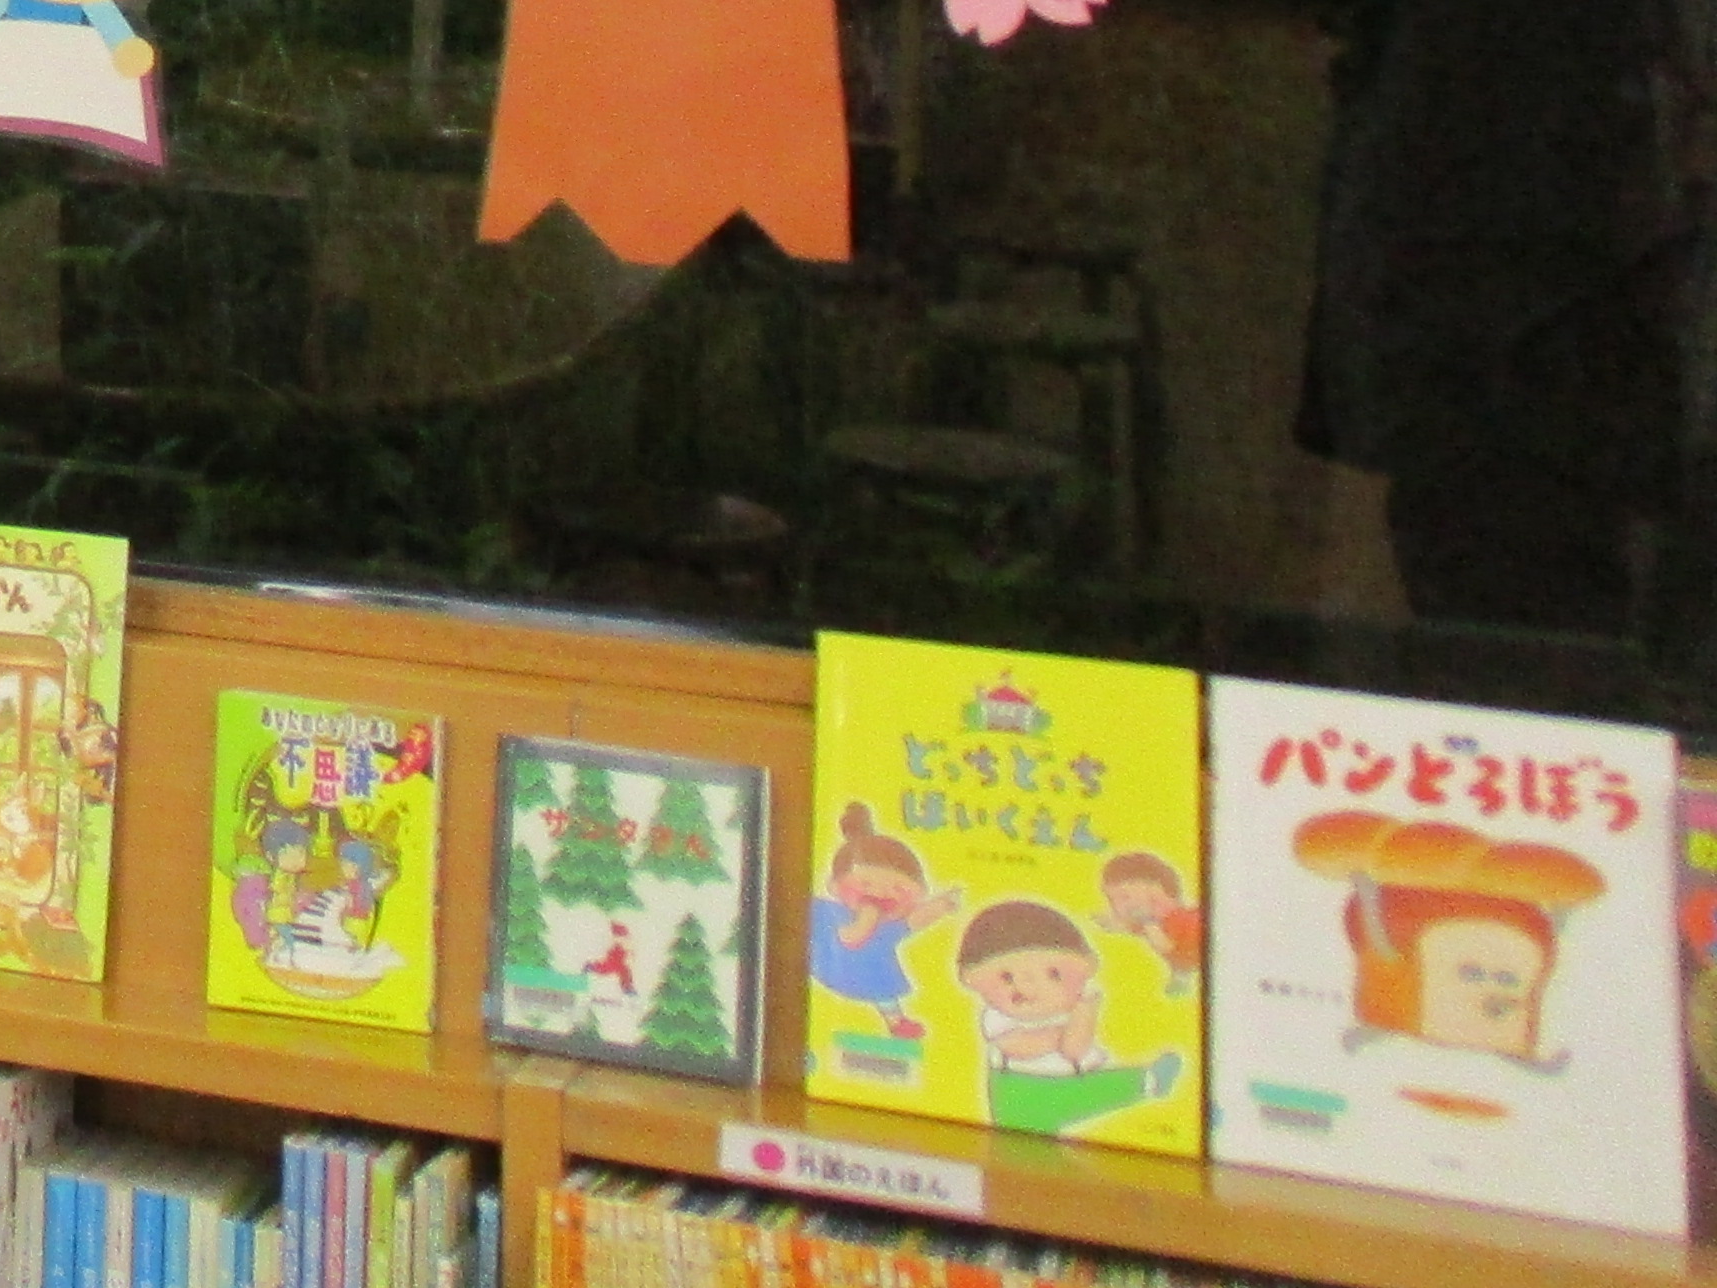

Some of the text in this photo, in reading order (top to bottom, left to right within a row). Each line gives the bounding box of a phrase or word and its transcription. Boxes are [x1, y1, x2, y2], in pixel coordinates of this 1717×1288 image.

[278, 736, 380, 802] 不思議
[1258, 727, 1642, 832] パンどろぼう
